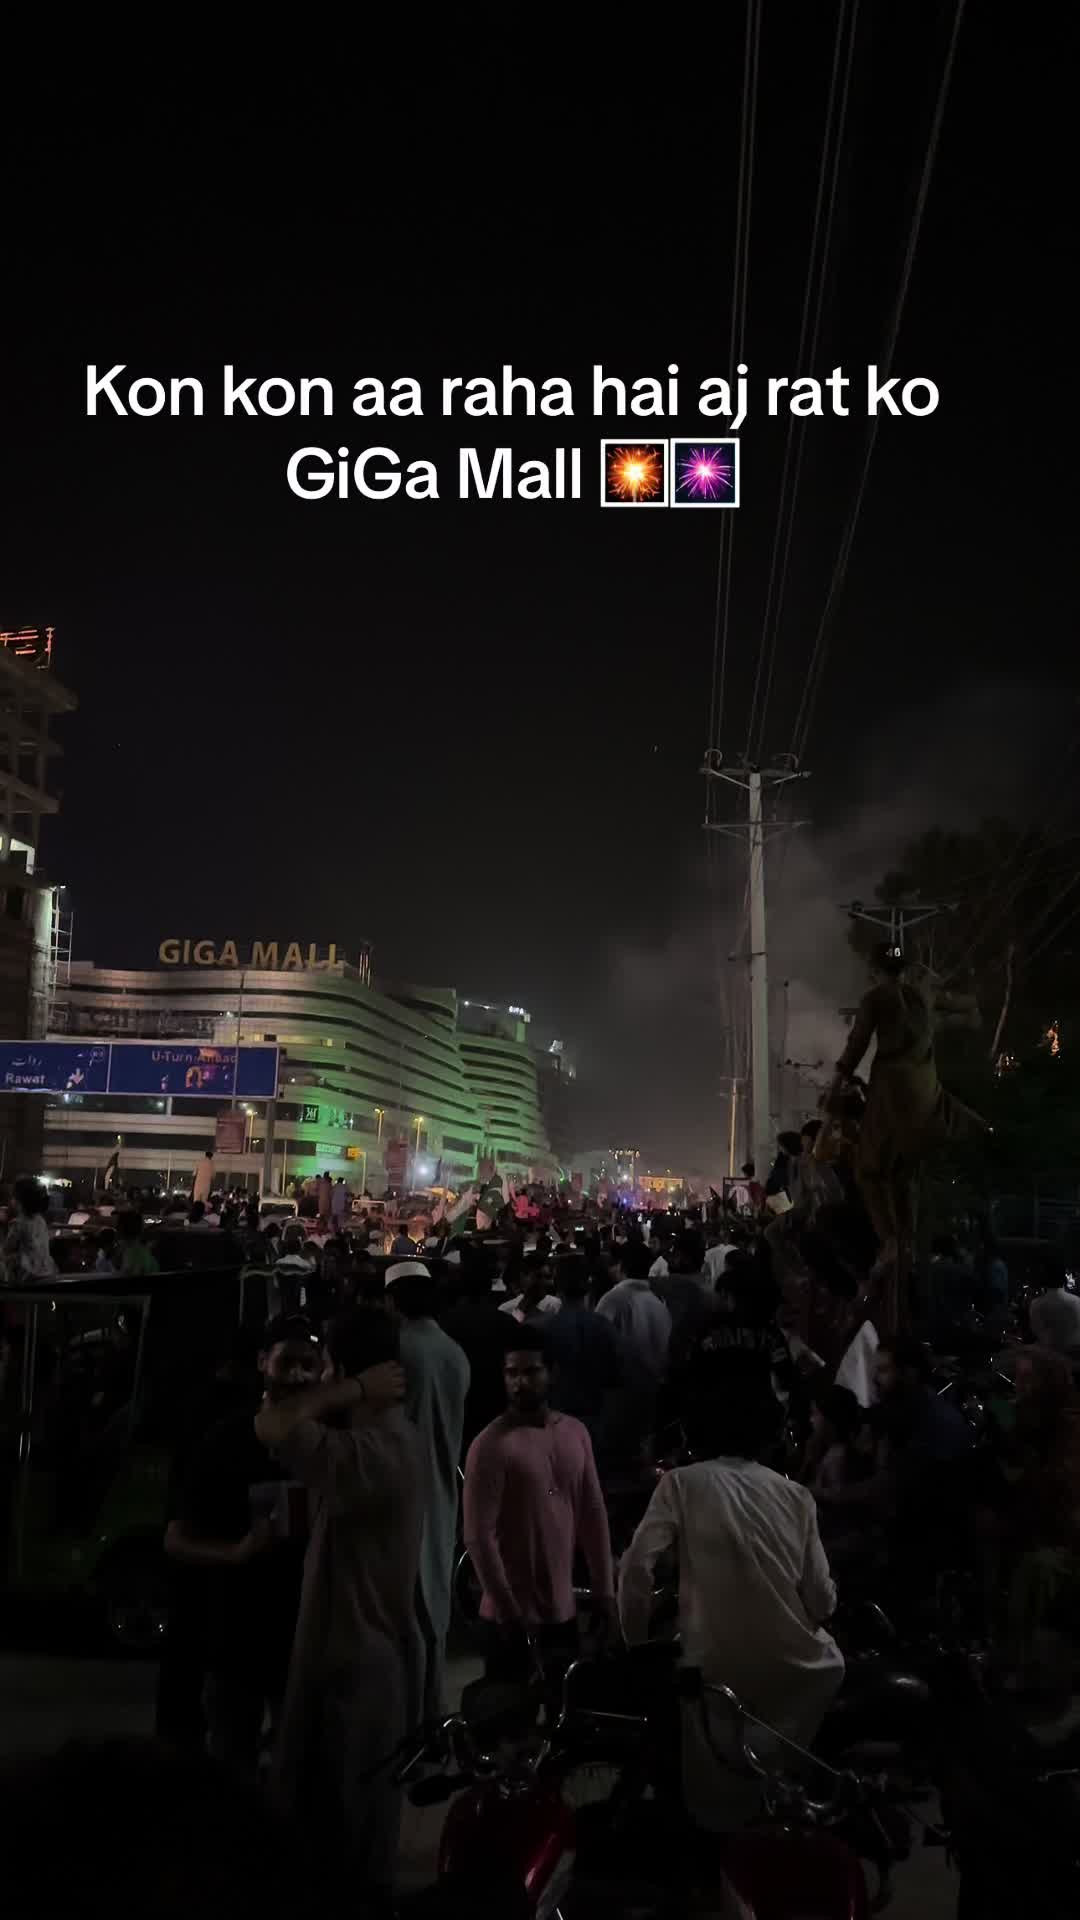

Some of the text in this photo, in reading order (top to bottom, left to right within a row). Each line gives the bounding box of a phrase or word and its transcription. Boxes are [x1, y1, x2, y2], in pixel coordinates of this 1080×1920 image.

[159, 939, 341, 970] GIGA MALL
[151, 1049, 193, 1064] U-Turn
[4, 1072, 46, 1085] Rawat
